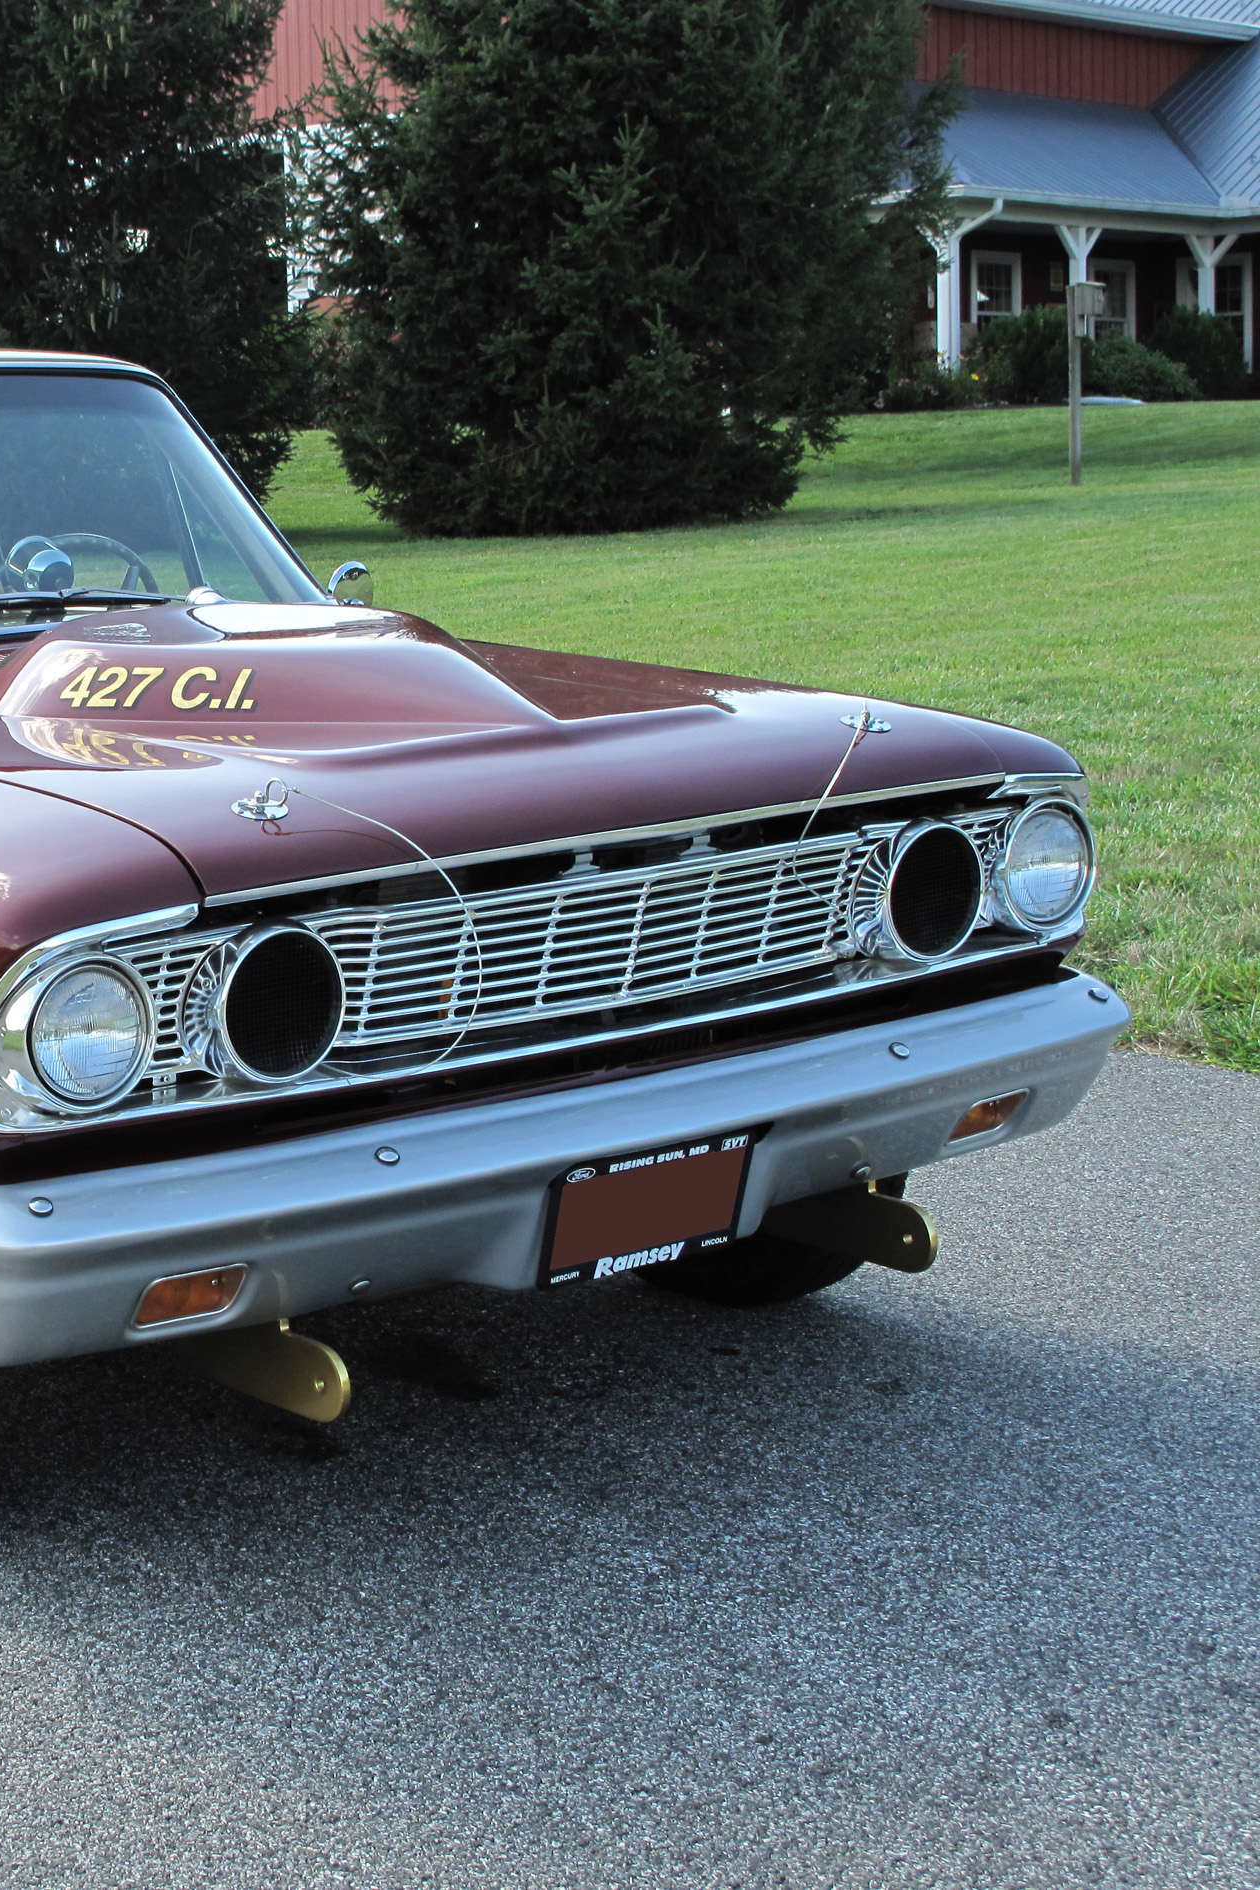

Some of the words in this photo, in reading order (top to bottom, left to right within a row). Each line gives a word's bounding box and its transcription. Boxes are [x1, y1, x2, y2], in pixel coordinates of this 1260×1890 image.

[60, 666, 166, 709] 427
[171, 666, 257, 711] C.I.
[723, 1135, 747, 1150] SVT
[608, 1156, 654, 1174] RISING
[656, 1150, 686, 1164] SUN,
[688, 1145, 710, 1156] MD
[701, 1236, 728, 1247] LINCOLN
[593, 1241, 685, 1280] Ramsey
[550, 1271, 580, 1284] MERCURY
